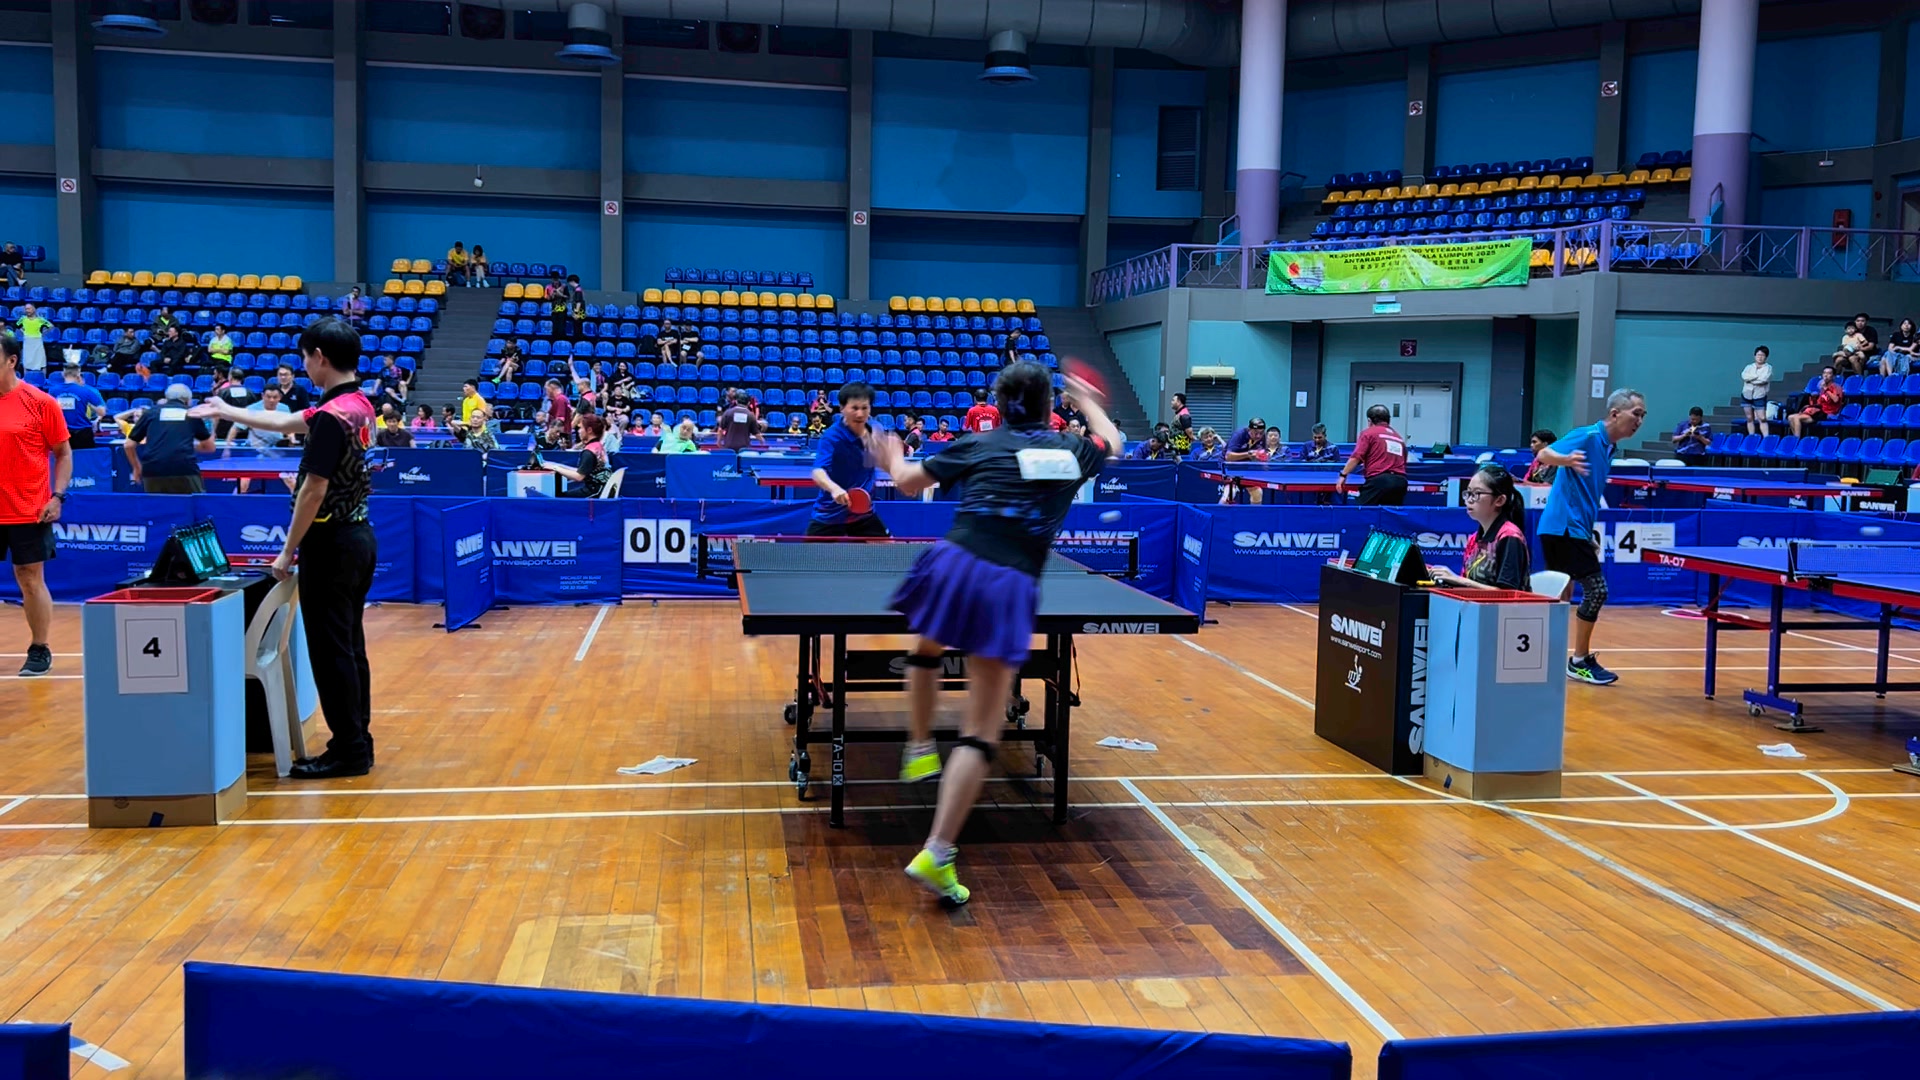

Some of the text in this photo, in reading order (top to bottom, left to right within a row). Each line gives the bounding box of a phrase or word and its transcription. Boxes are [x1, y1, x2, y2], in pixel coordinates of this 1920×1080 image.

[1329, 251, 1377, 259] KEJOHANAN
[1378, 248, 1398, 256] PING
[1465, 243, 1511, 251] JEMPUTAN
[1404, 346, 1413, 356] 3
[1840, 490, 1871, 498] SANWEI
[1859, 501, 1896, 512] SANWEI
[52, 522, 147, 544] ANWEI
[1054, 530, 1139, 546] ANWE
[1233, 531, 1340, 549] SANWEI
[1416, 532, 1468, 548] SAN
[56, 541, 146, 552] anweisport.com
[491, 541, 577, 557] NWEI
[1234, 549, 1339, 557] www.sanweisport.com
[492, 559, 577, 567] anweisport.com
[1658, 554, 1686, 568] TA-07
[1082, 622, 1160, 634] SANWEI
[1330, 613, 1383, 648] SANWEI
[142, 636, 162, 658] 4
[1330, 635, 1382, 660] www.sanweisport.com
[1516, 633, 1530, 653] 3
[1408, 618, 1429, 755] SANWEI
[833, 734, 844, 771] TA-10
